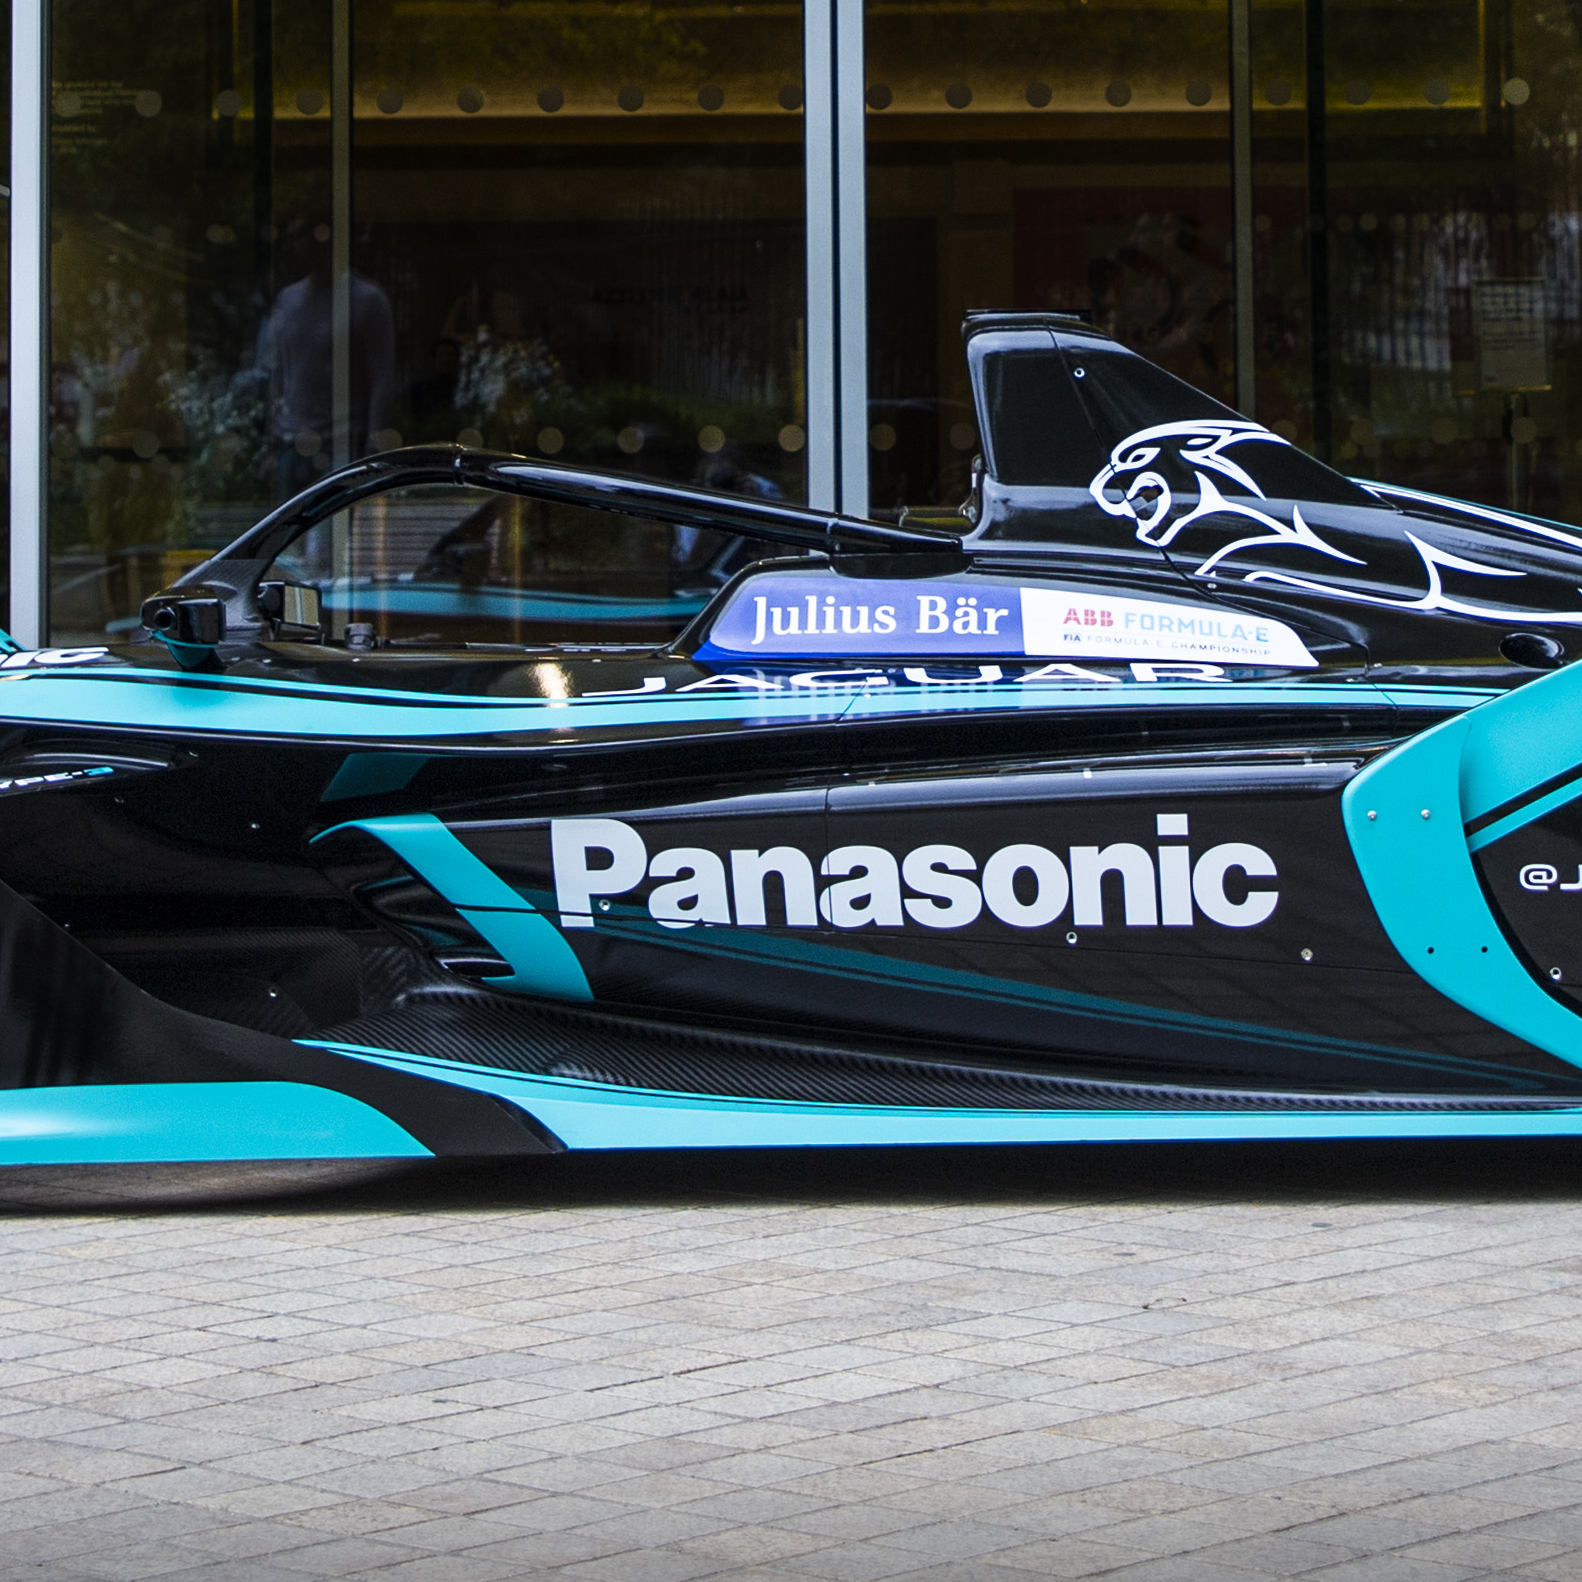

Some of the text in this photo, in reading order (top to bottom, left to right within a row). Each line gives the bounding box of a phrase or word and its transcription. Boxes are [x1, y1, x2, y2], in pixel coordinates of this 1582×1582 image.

[751, 594, 1010, 646] Julius Bär
[1063, 607, 1114, 627] ABB
[1063, 633, 1082, 643] FIA
[1170, 641, 1271, 656] CHAMPIONSHIP
[581, 662, 1235, 698] JAGUAR
[550, 813, 1279, 929] Panasonic
